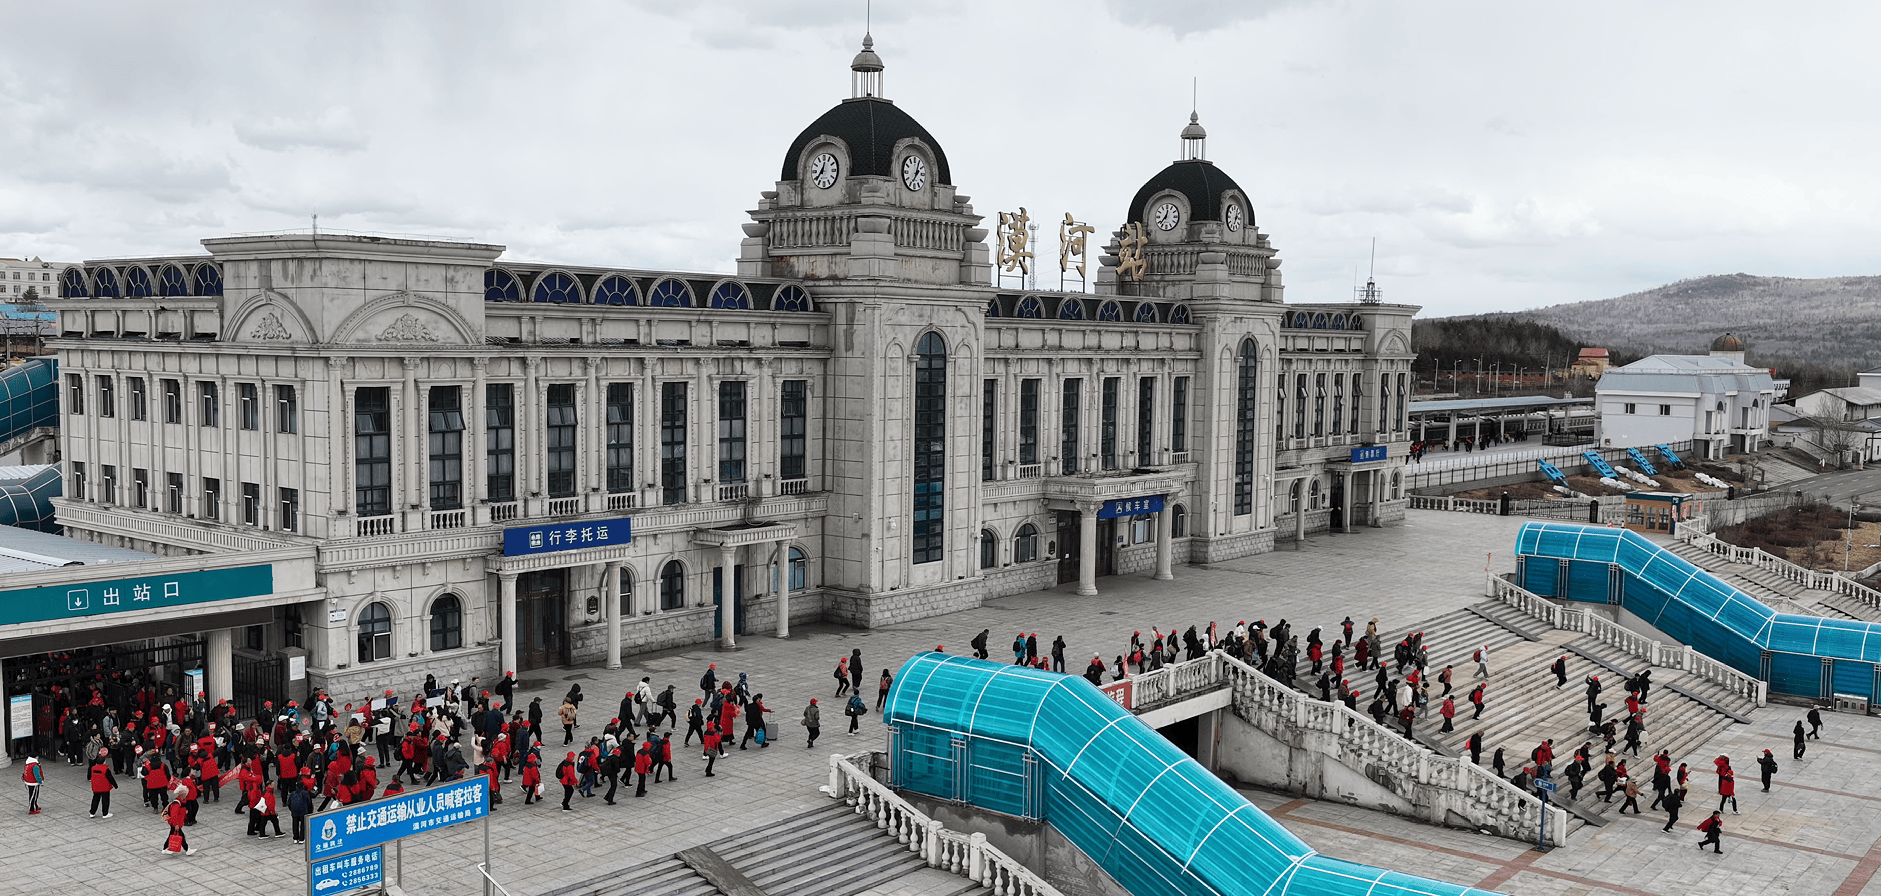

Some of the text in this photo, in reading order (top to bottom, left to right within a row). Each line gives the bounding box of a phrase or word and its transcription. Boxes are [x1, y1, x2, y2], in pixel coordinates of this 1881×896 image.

[997, 207, 1148, 281] 漠河站
[1125, 499, 1150, 512] 候车室
[548, 526, 609, 546] 行李托运
[103, 581, 180, 607] 出站口
[346, 783, 482, 835] 禁止交通运输从业人员喊客拉客
[314, 851, 378, 877] 出租车叫车服务电话
[348, 863, 379, 877] 2886789
[348, 872, 379, 886] 2856333
